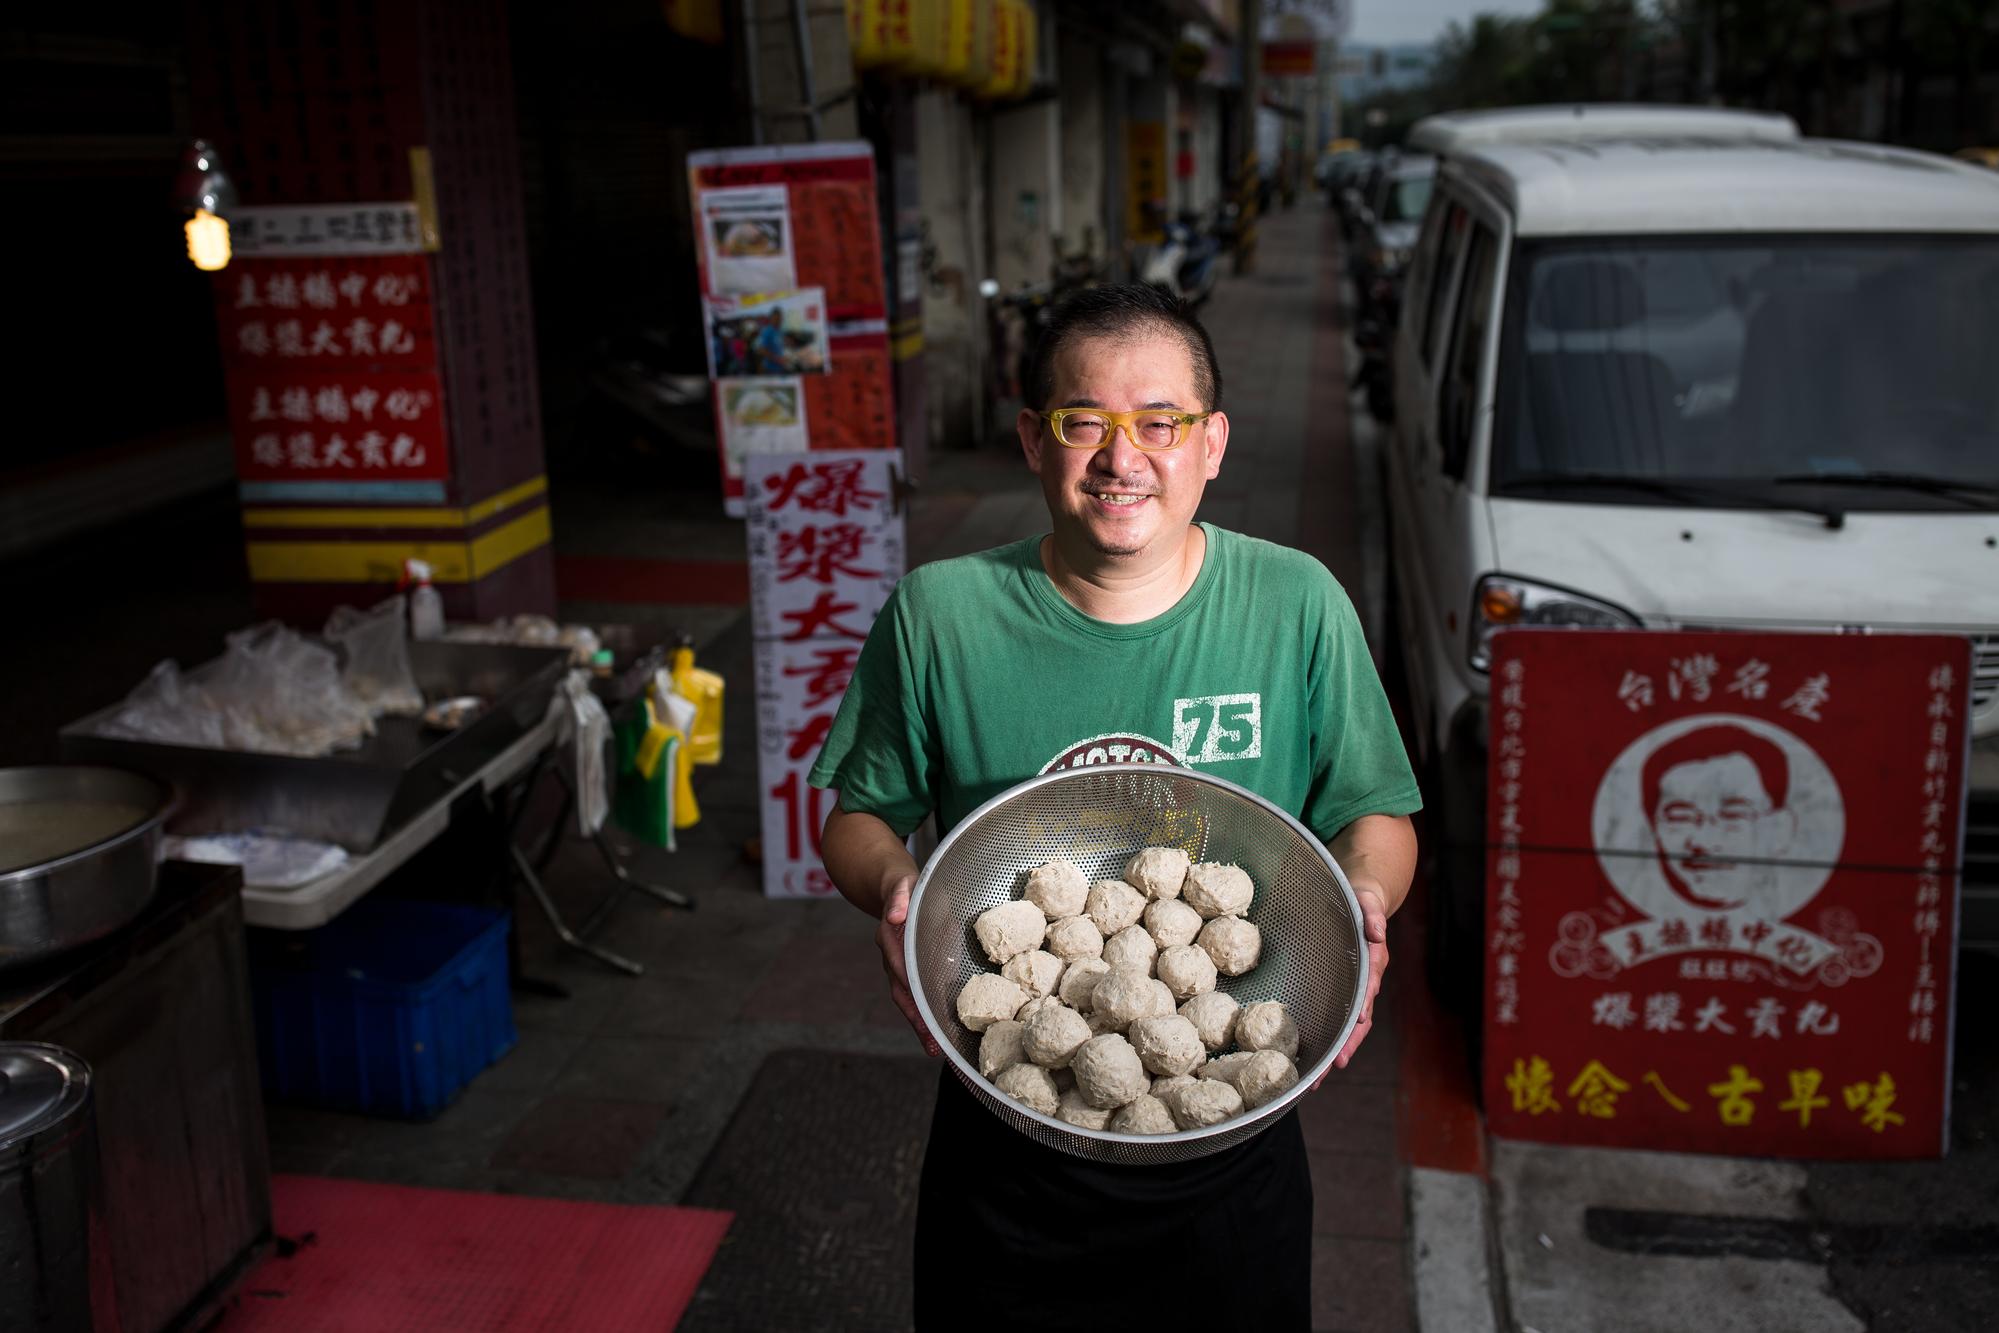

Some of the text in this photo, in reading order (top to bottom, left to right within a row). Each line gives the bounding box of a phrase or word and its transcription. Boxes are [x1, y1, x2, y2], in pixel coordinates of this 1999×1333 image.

[1616, 651, 1831, 723] 台灣名產
[1182, 699, 1254, 759] 75
